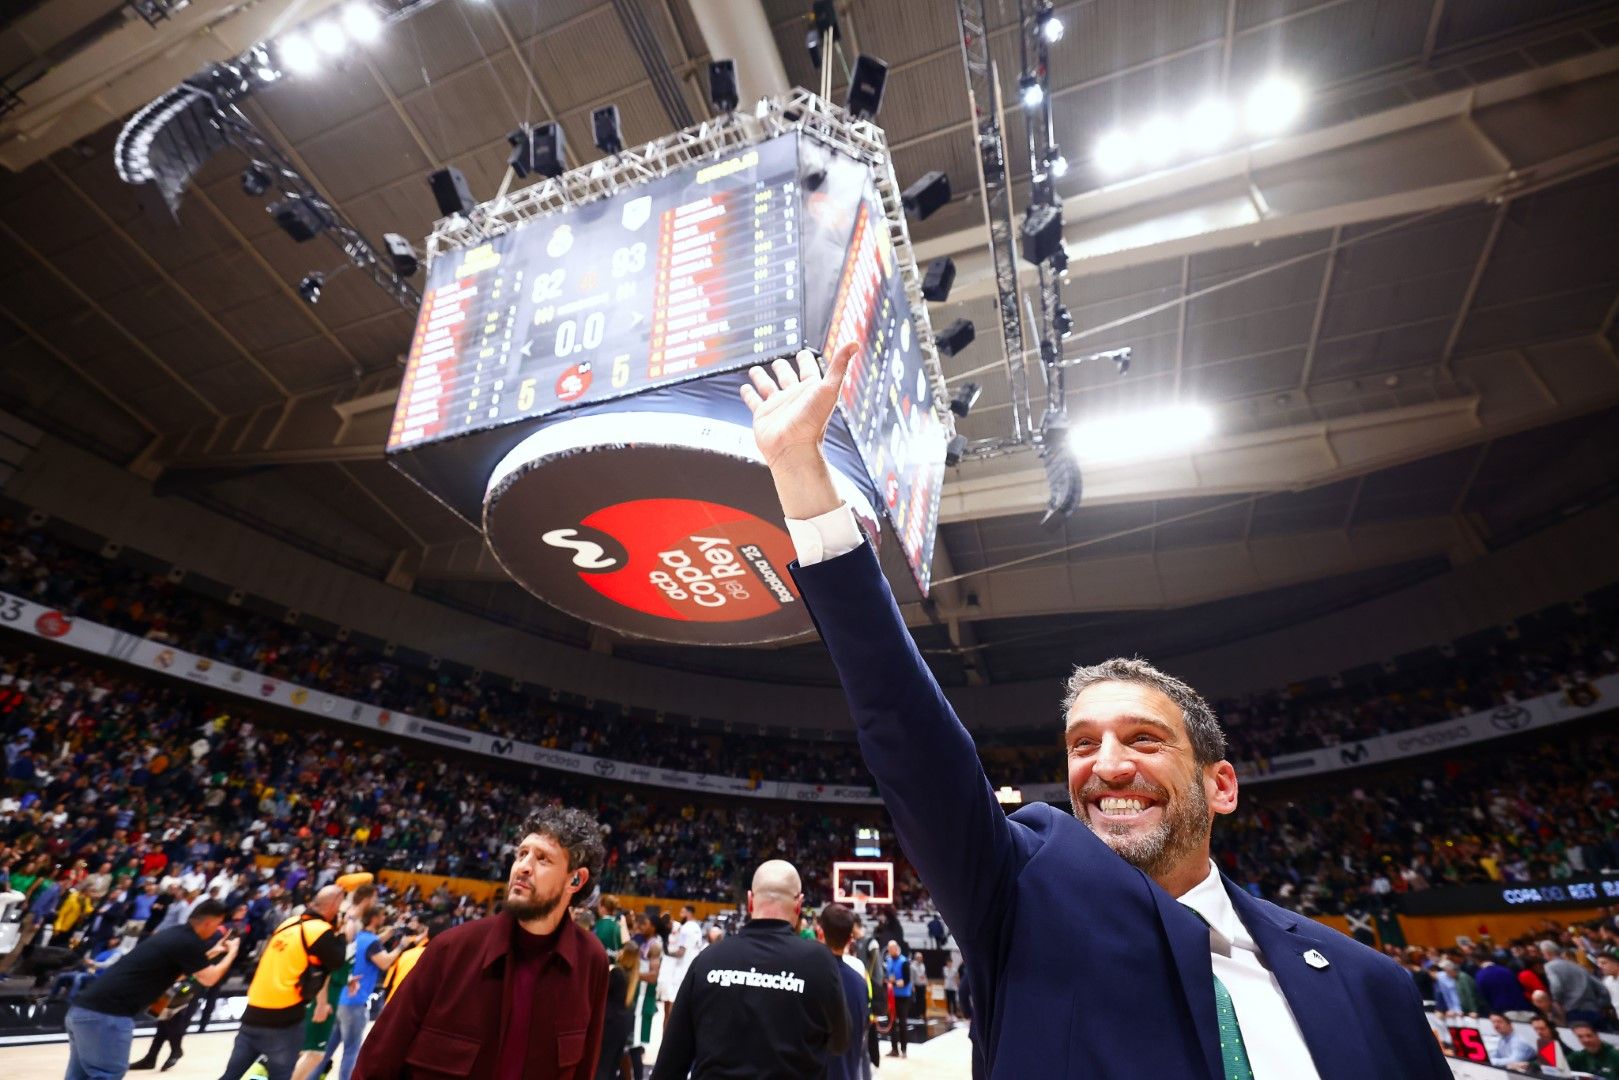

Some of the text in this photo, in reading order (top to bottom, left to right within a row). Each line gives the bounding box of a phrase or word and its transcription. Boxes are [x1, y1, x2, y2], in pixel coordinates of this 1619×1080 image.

[532, 268, 566, 304] 82
[611, 242, 648, 278] 93
[555, 312, 605, 357] 0.0
[518, 379, 537, 411] 5
[611, 353, 630, 388] 5
[657, 550, 727, 608] Copa
[690, 536, 746, 579] Rey
[649, 570, 688, 601] acb
[707, 967, 806, 994] organización
[1459, 1030, 1488, 1061] 5
